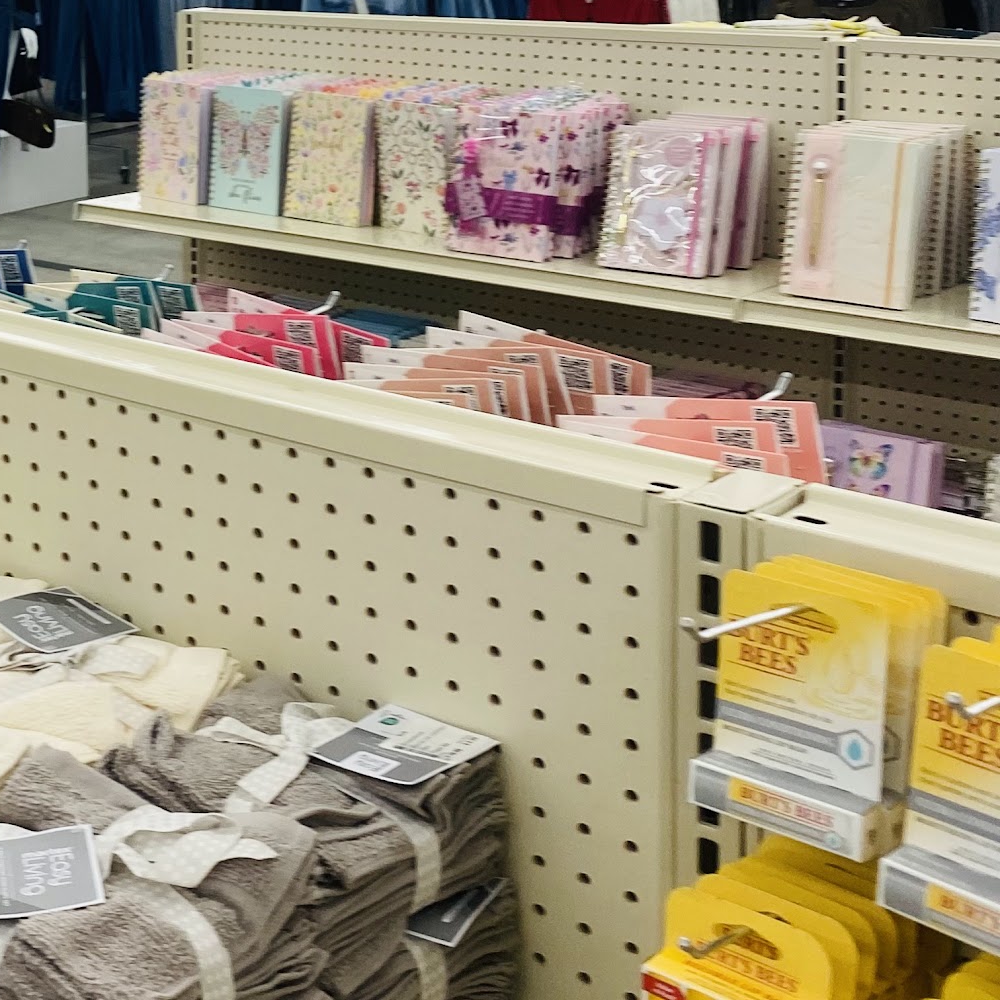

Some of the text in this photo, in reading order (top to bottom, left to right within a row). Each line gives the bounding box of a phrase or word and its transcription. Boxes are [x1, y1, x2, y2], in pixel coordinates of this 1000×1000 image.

[739, 642, 797, 675] BEES
[794, 804, 834, 828] BEES
[755, 964, 799, 993] BEES
